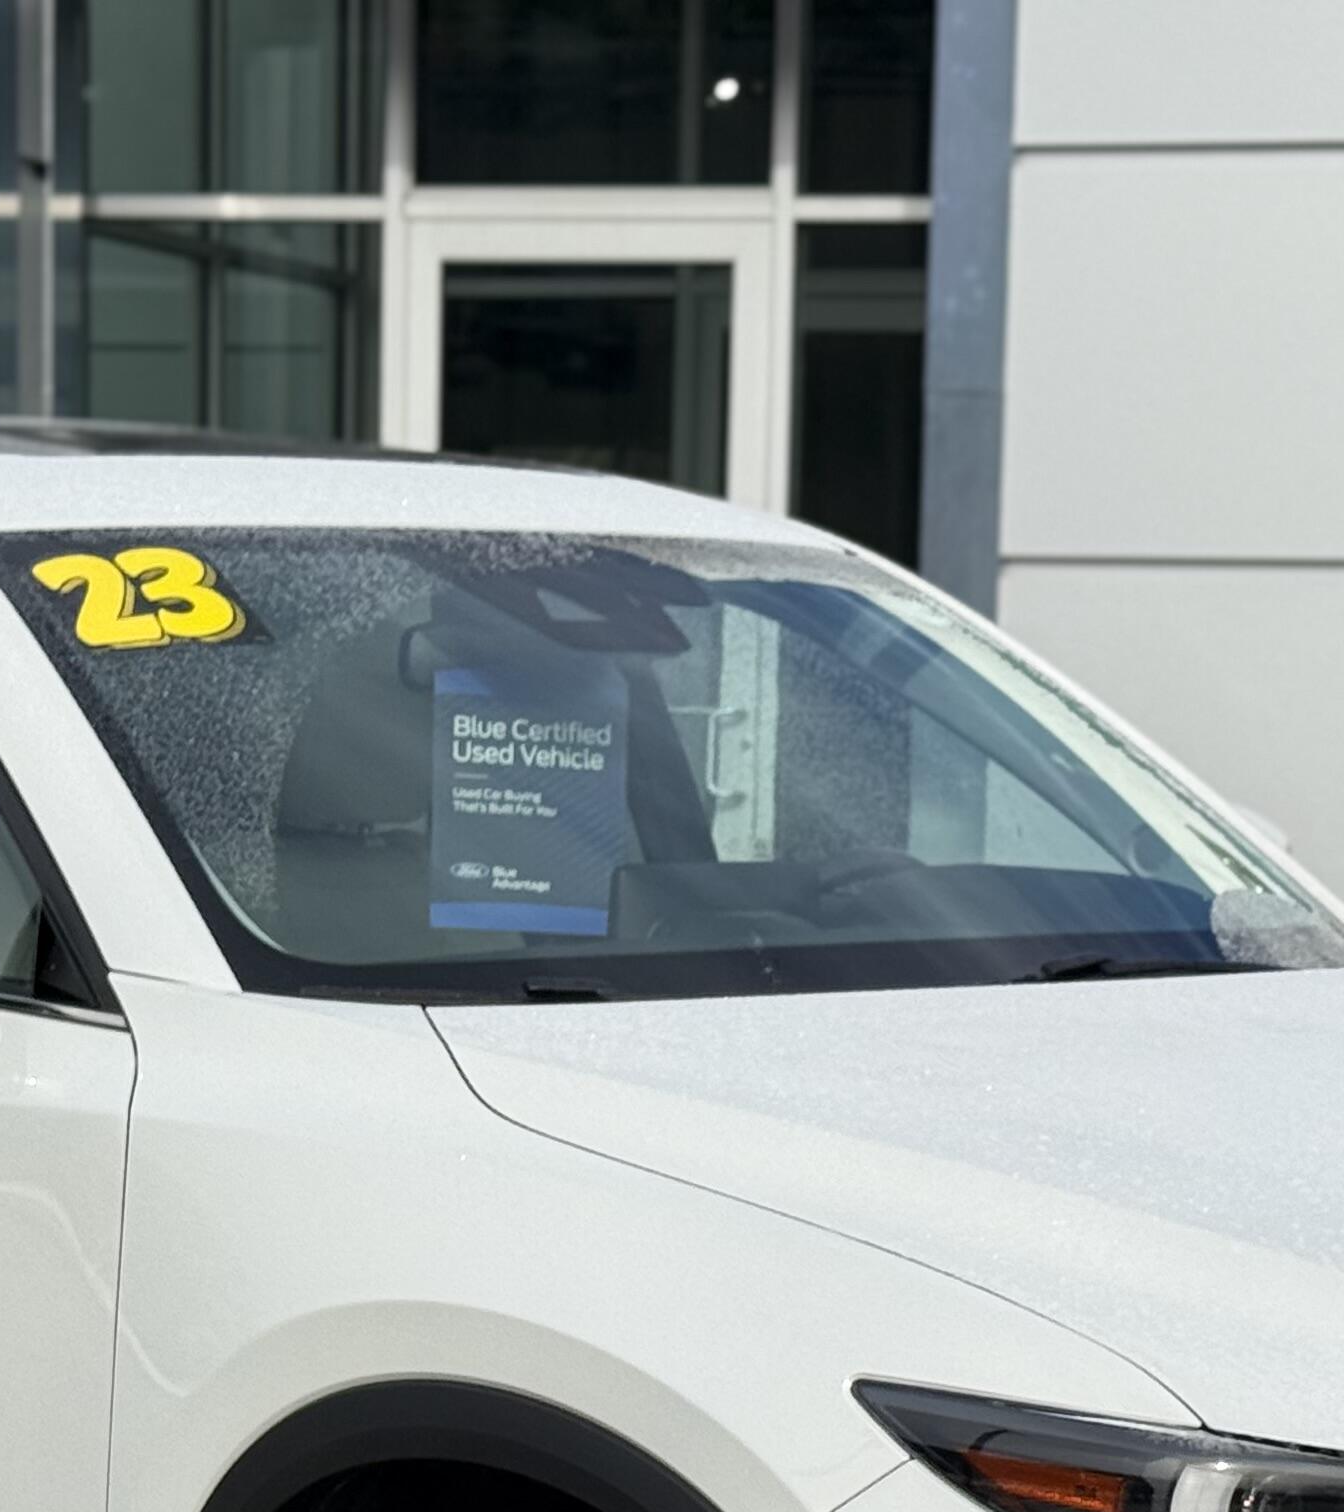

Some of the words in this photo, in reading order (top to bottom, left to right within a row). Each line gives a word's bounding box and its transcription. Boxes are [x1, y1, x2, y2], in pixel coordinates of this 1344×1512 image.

[32, 547, 246, 650] 23
[453, 714, 506, 740] Blue
[512, 718, 612, 746] Certified
[452, 740, 514, 766] Used
[520, 744, 604, 771] Vehicle
[452, 787, 482, 800] Used
[484, 788, 502, 800] Car
[504, 789, 542, 804] Buying
[452, 800, 486, 814] That's
[488, 802, 514, 816] Built
[516, 804, 534, 816] For
[492, 866, 518, 878] Blue
[492, 878, 552, 892] Advantage
